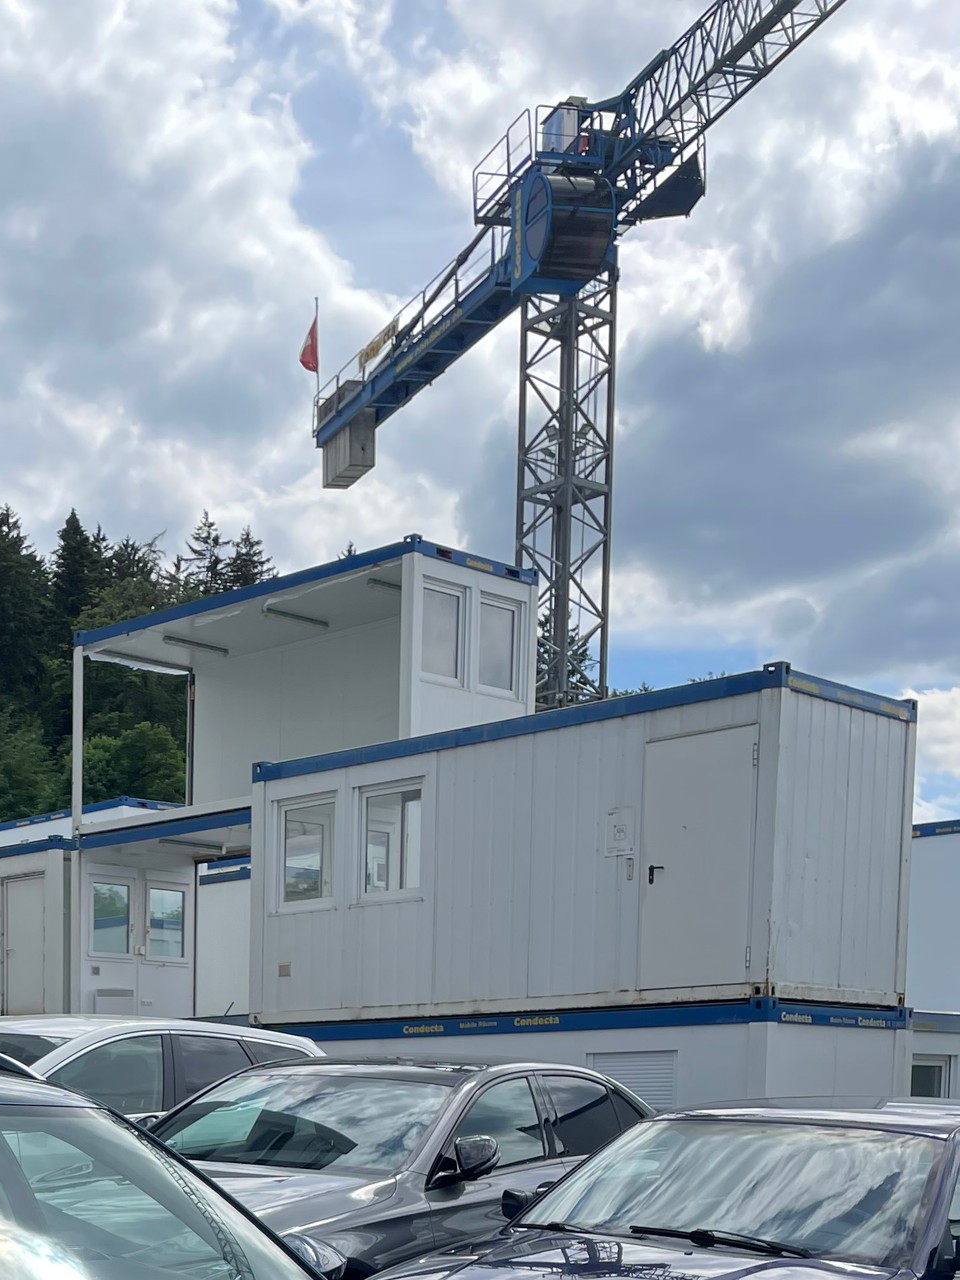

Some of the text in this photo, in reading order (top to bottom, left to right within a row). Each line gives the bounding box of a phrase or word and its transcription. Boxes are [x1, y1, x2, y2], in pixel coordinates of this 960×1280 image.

[403, 1024, 444, 1034] Condecta
[514, 1016, 559, 1026] Condecta
[781, 1011, 812, 1024] Condecta
[858, 1016, 886, 1028] Condecta
